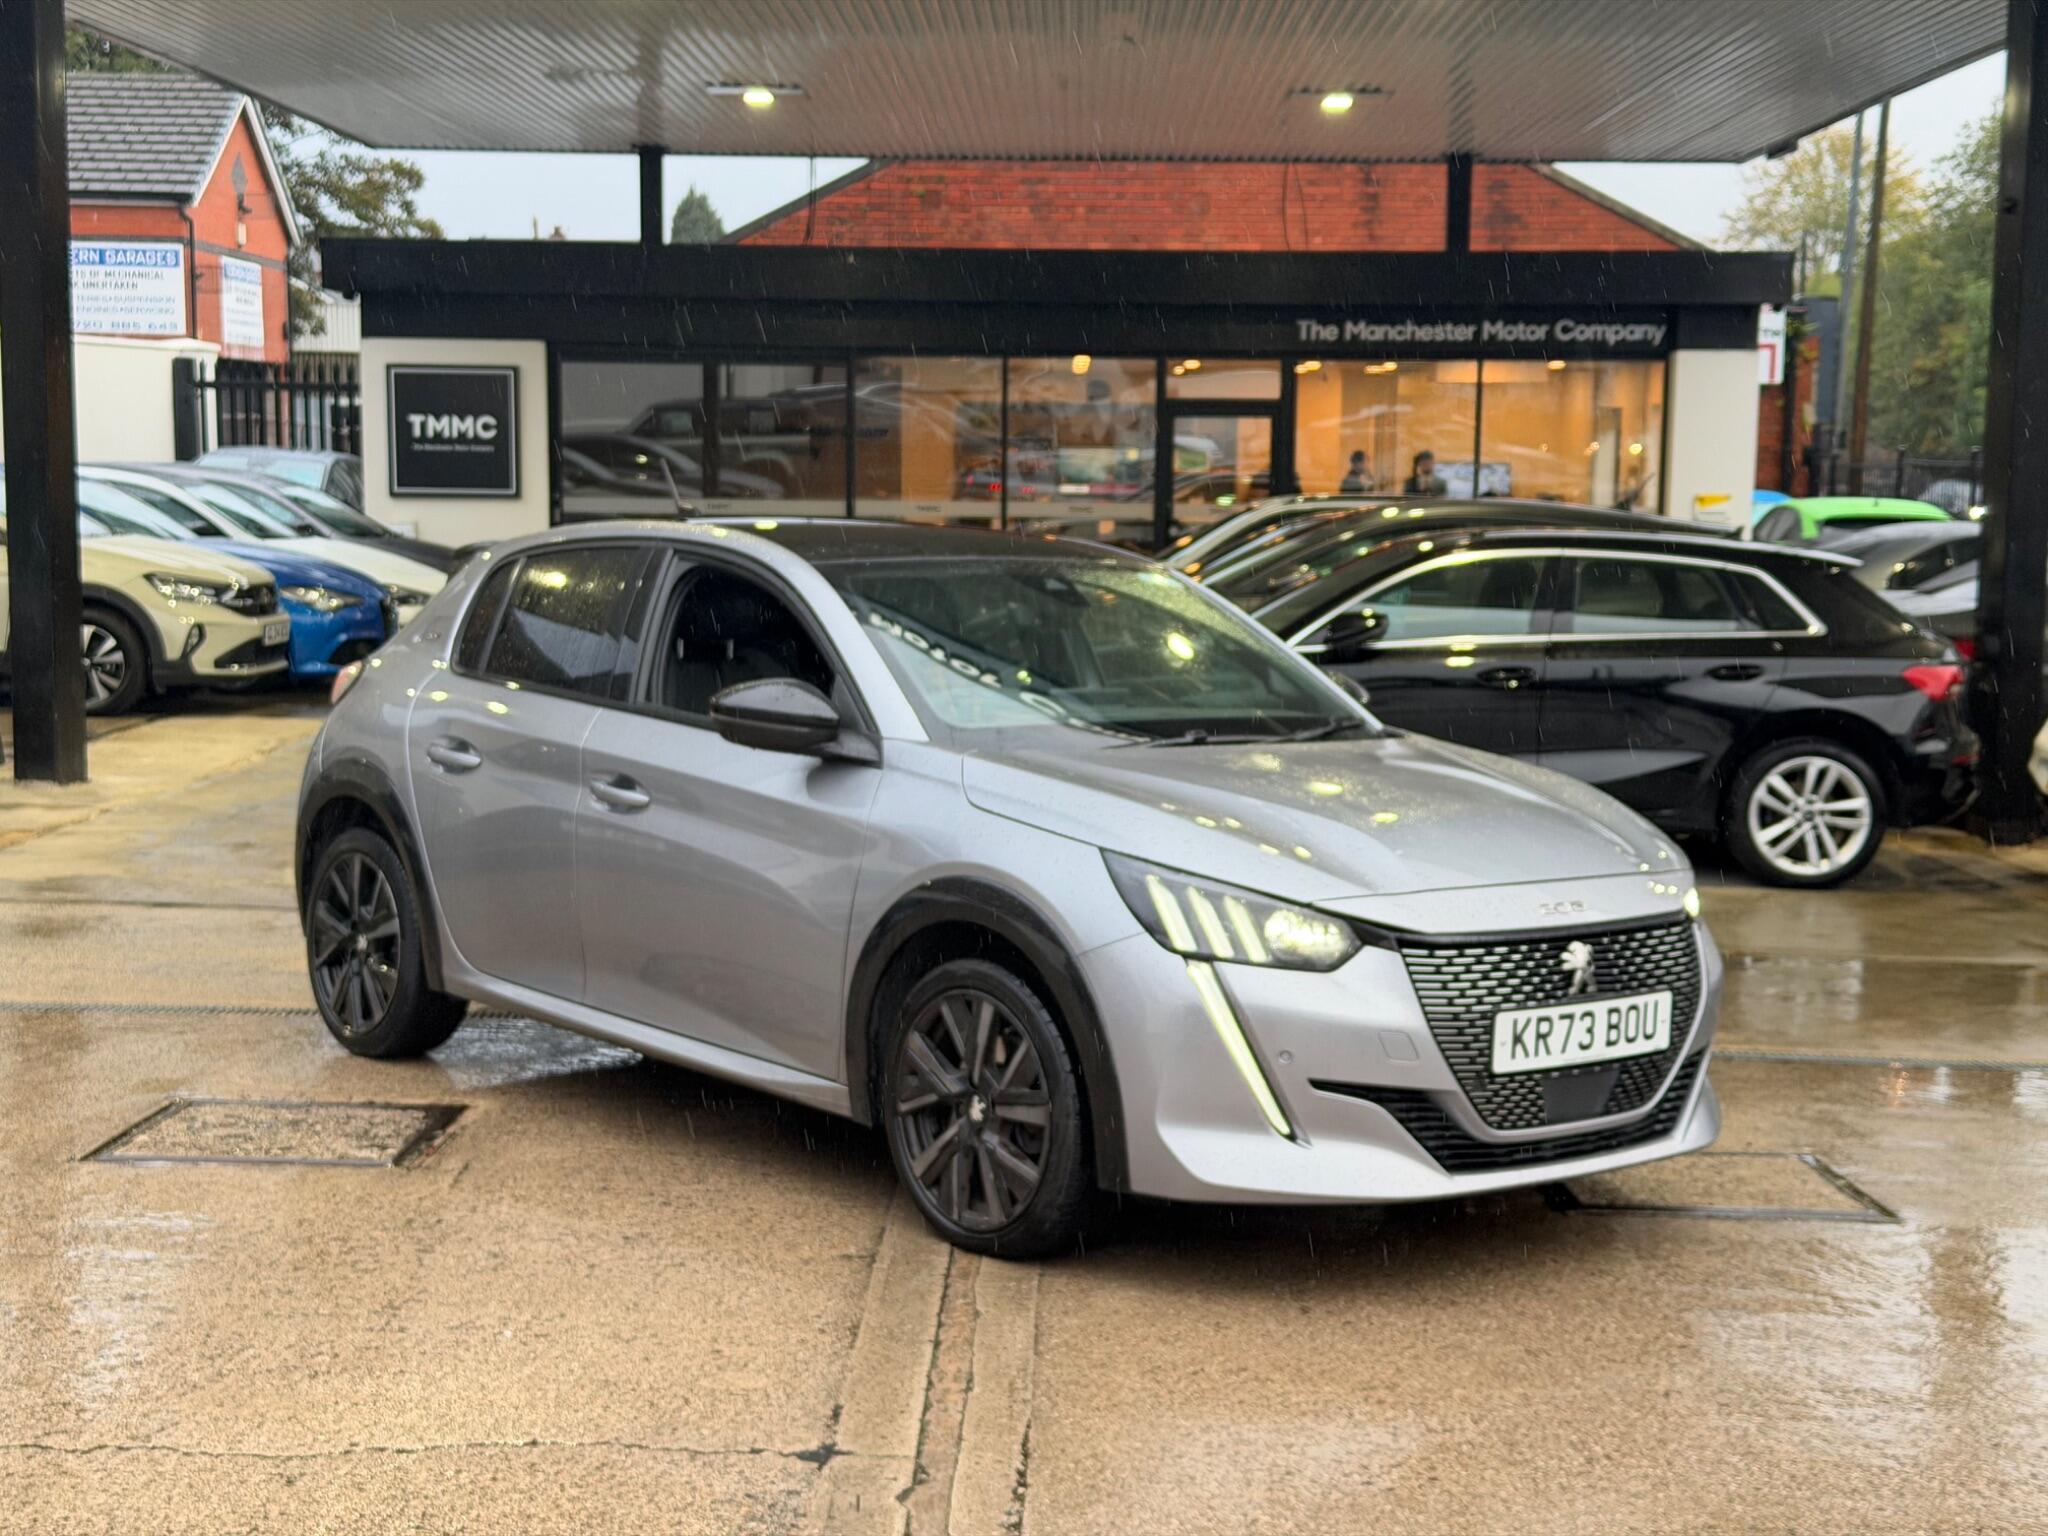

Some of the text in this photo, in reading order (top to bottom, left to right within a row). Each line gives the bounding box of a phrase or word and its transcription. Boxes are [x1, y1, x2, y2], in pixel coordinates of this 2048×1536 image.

[105, 249, 177, 266] GARAGES
[104, 270, 164, 280] MECHANICAL
[1297, 319, 1666, 346] The Manchester Motor Company
[407, 413, 498, 440] TMMC
[1511, 999, 1659, 1060] KR73 BOU
